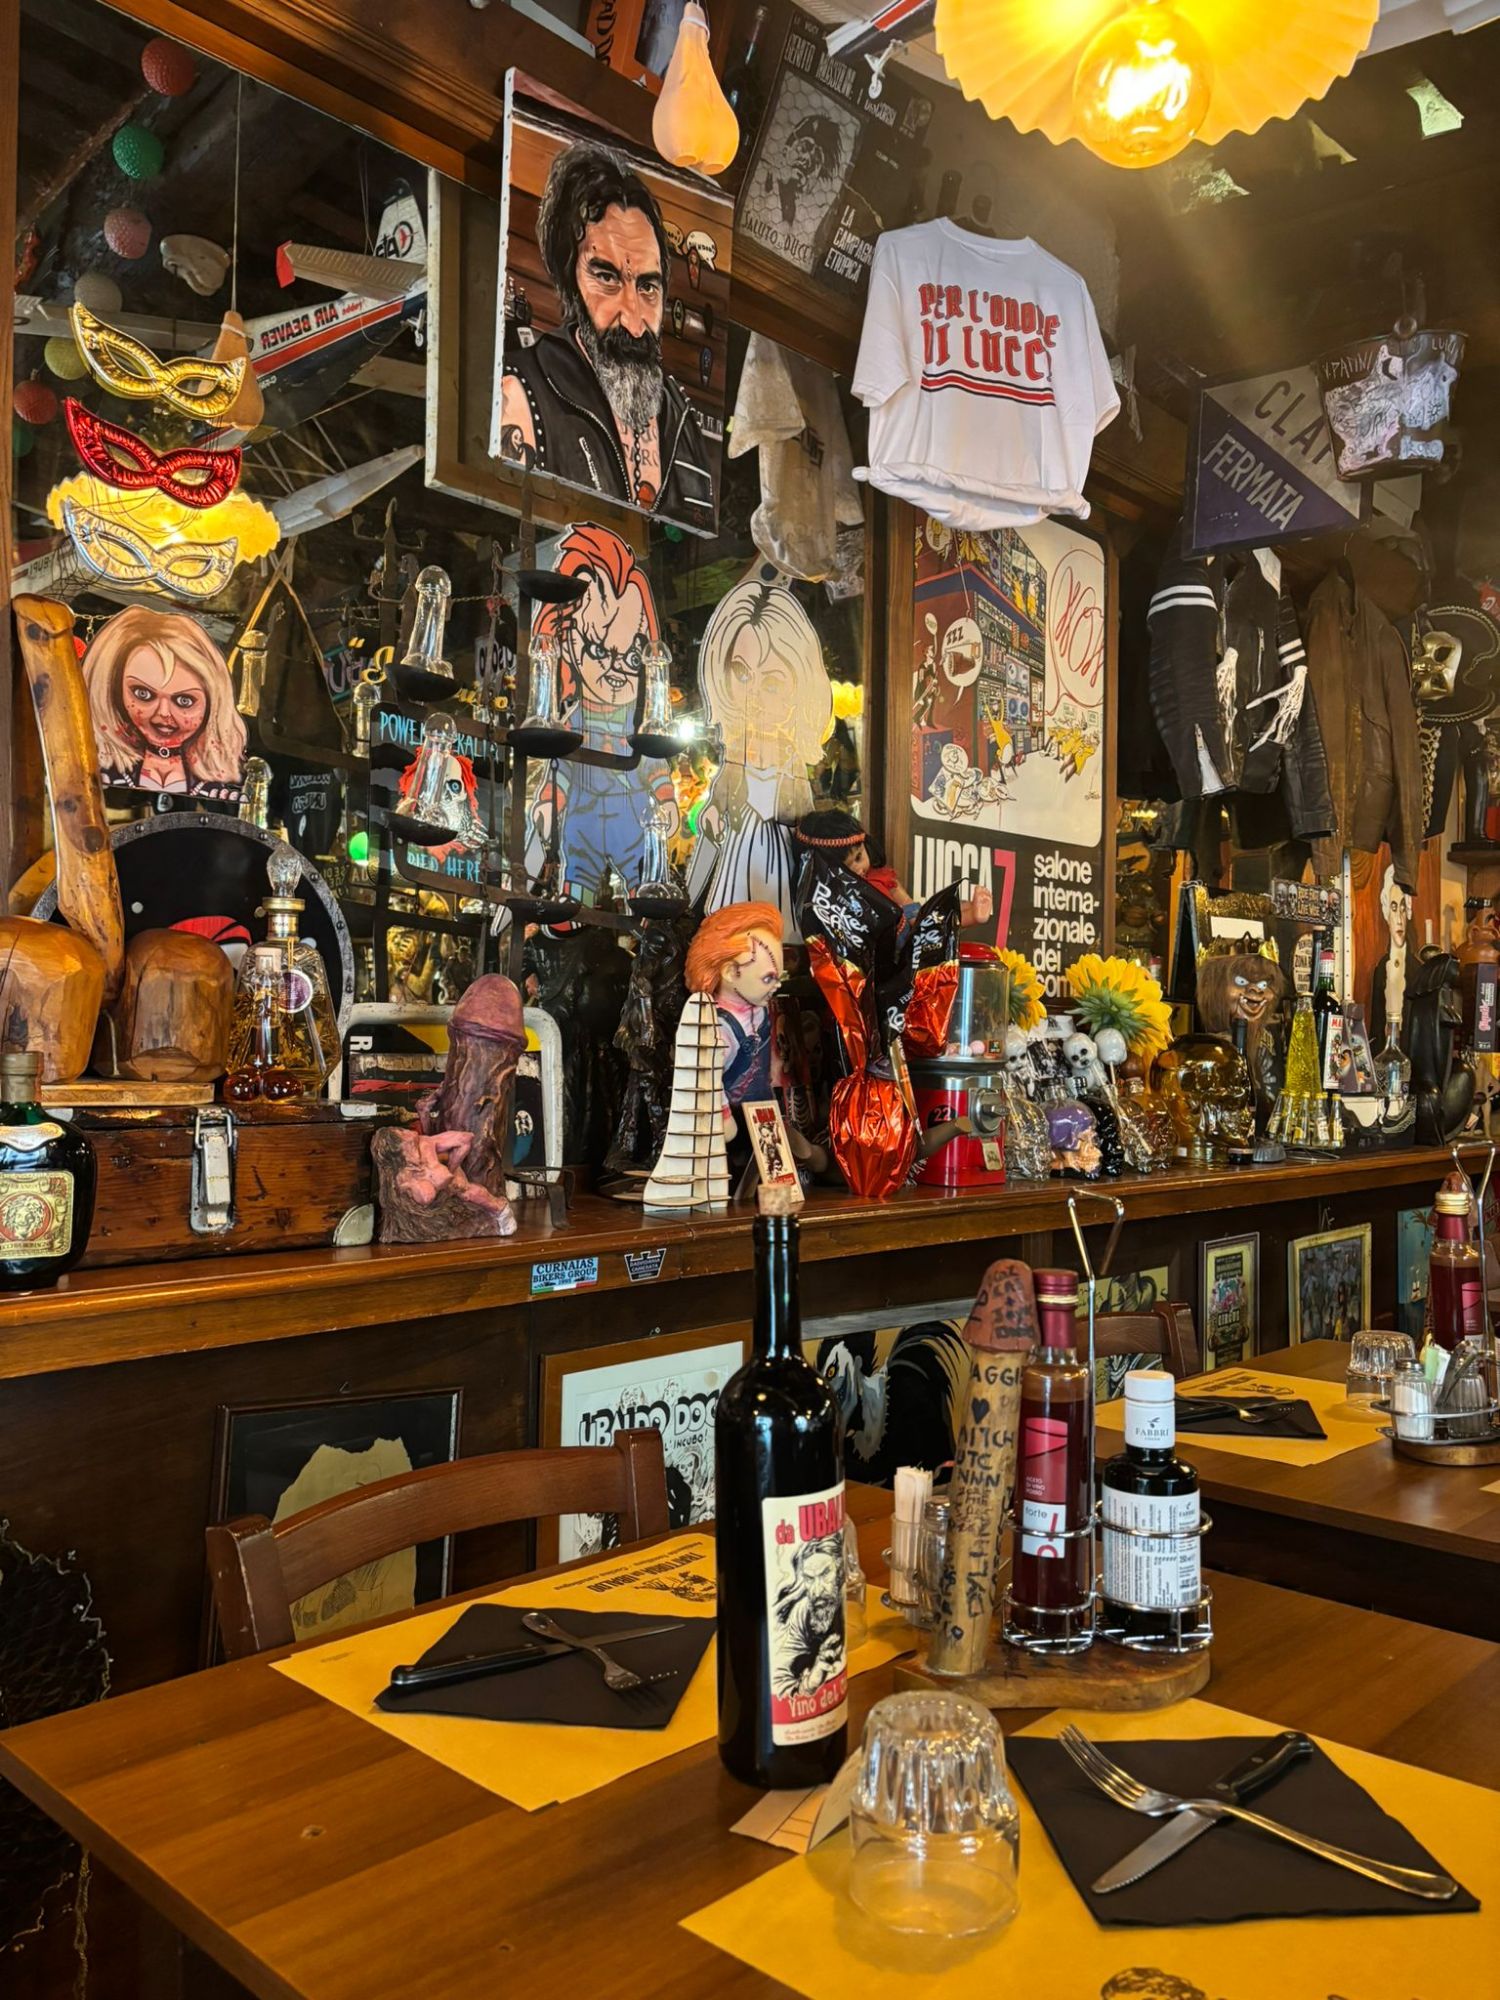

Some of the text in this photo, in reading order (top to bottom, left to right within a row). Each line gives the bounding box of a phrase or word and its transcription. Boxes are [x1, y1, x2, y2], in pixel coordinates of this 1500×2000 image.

[784, 33, 816, 73] BENITO
[743, 210, 778, 244] SALUTO
[840, 204, 857, 227] LA
[824, 247, 863, 283] ETIOPICA
[918, 282, 965, 320] PER
[920, 318, 1053, 383] DI LUCC
[1201, 432, 1305, 532] FERMATA
[1033, 850, 1092, 885] salone
[811, 880, 870, 935] Pocket
[912, 834, 1017, 950] LUCCA 7
[1033, 877, 1100, 914] interna-
[1033, 911, 1096, 945] zionale
[1033, 941, 1061, 973] dei
[933, 1107, 949, 1122] 22
[532, 1267, 597, 1284] BIKERS GROUP
[535, 1258, 595, 1275] CURNAIAS
[1134, 1426, 1169, 1437] FABBRI
[1025, 1505, 1048, 1519] forte
[775, 1519, 795, 1545] da
[644, 1551, 706, 1575] TRATTORIA
[586, 1573, 640, 1593] UBALDO
[788, 1697, 817, 1718] Vino
[820, 1684, 839, 1708] del
